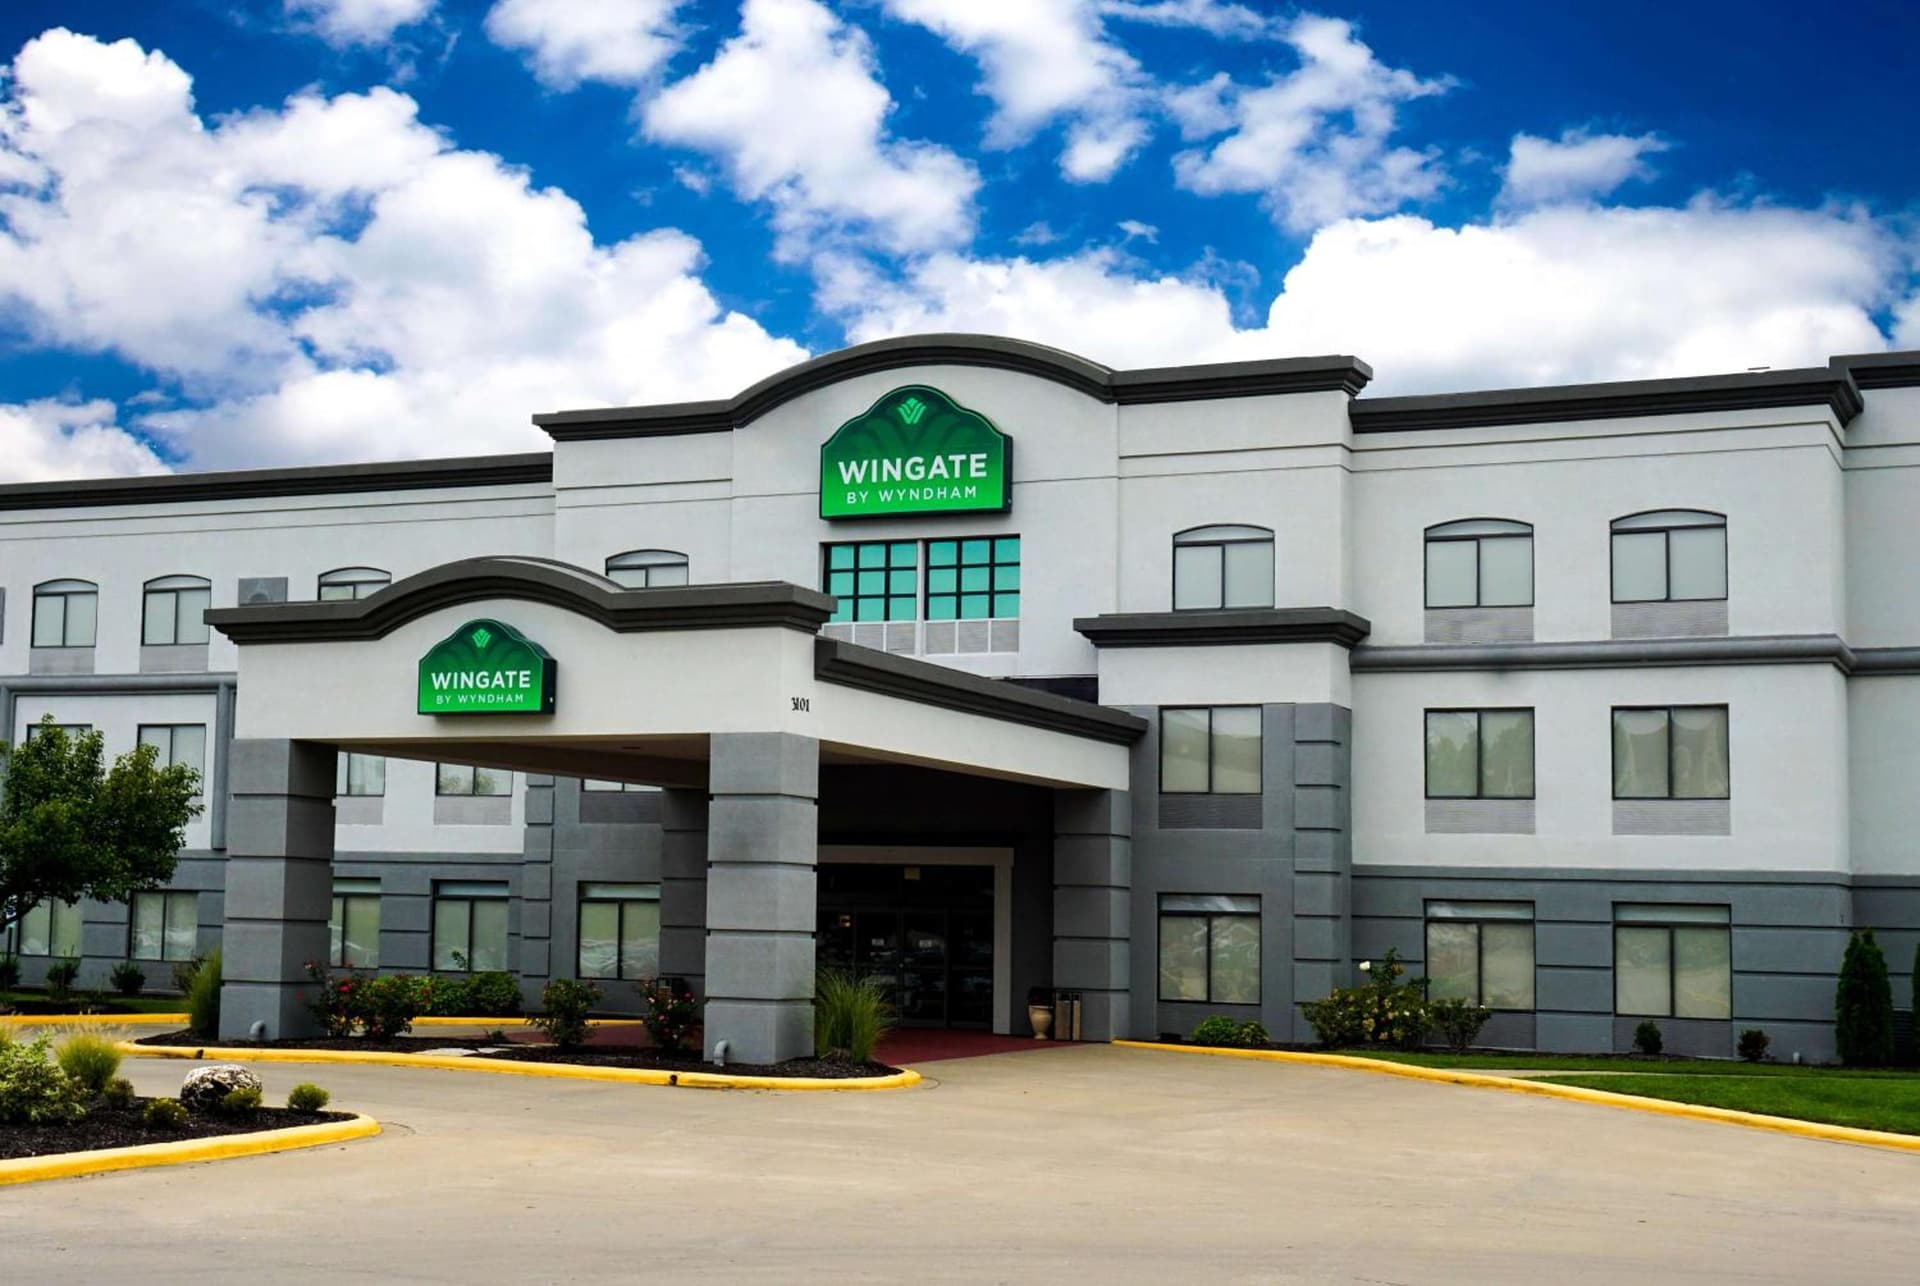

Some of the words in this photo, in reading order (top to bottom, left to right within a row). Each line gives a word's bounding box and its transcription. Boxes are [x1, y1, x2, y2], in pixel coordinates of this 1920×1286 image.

[838, 453, 988, 484] WINGATE
[847, 491, 868, 504] BY
[879, 486, 977, 502] WYNDHAM
[431, 670, 531, 689] WINGATE
[436, 695, 451, 704] BY
[458, 693, 524, 703] WYNDHAM
